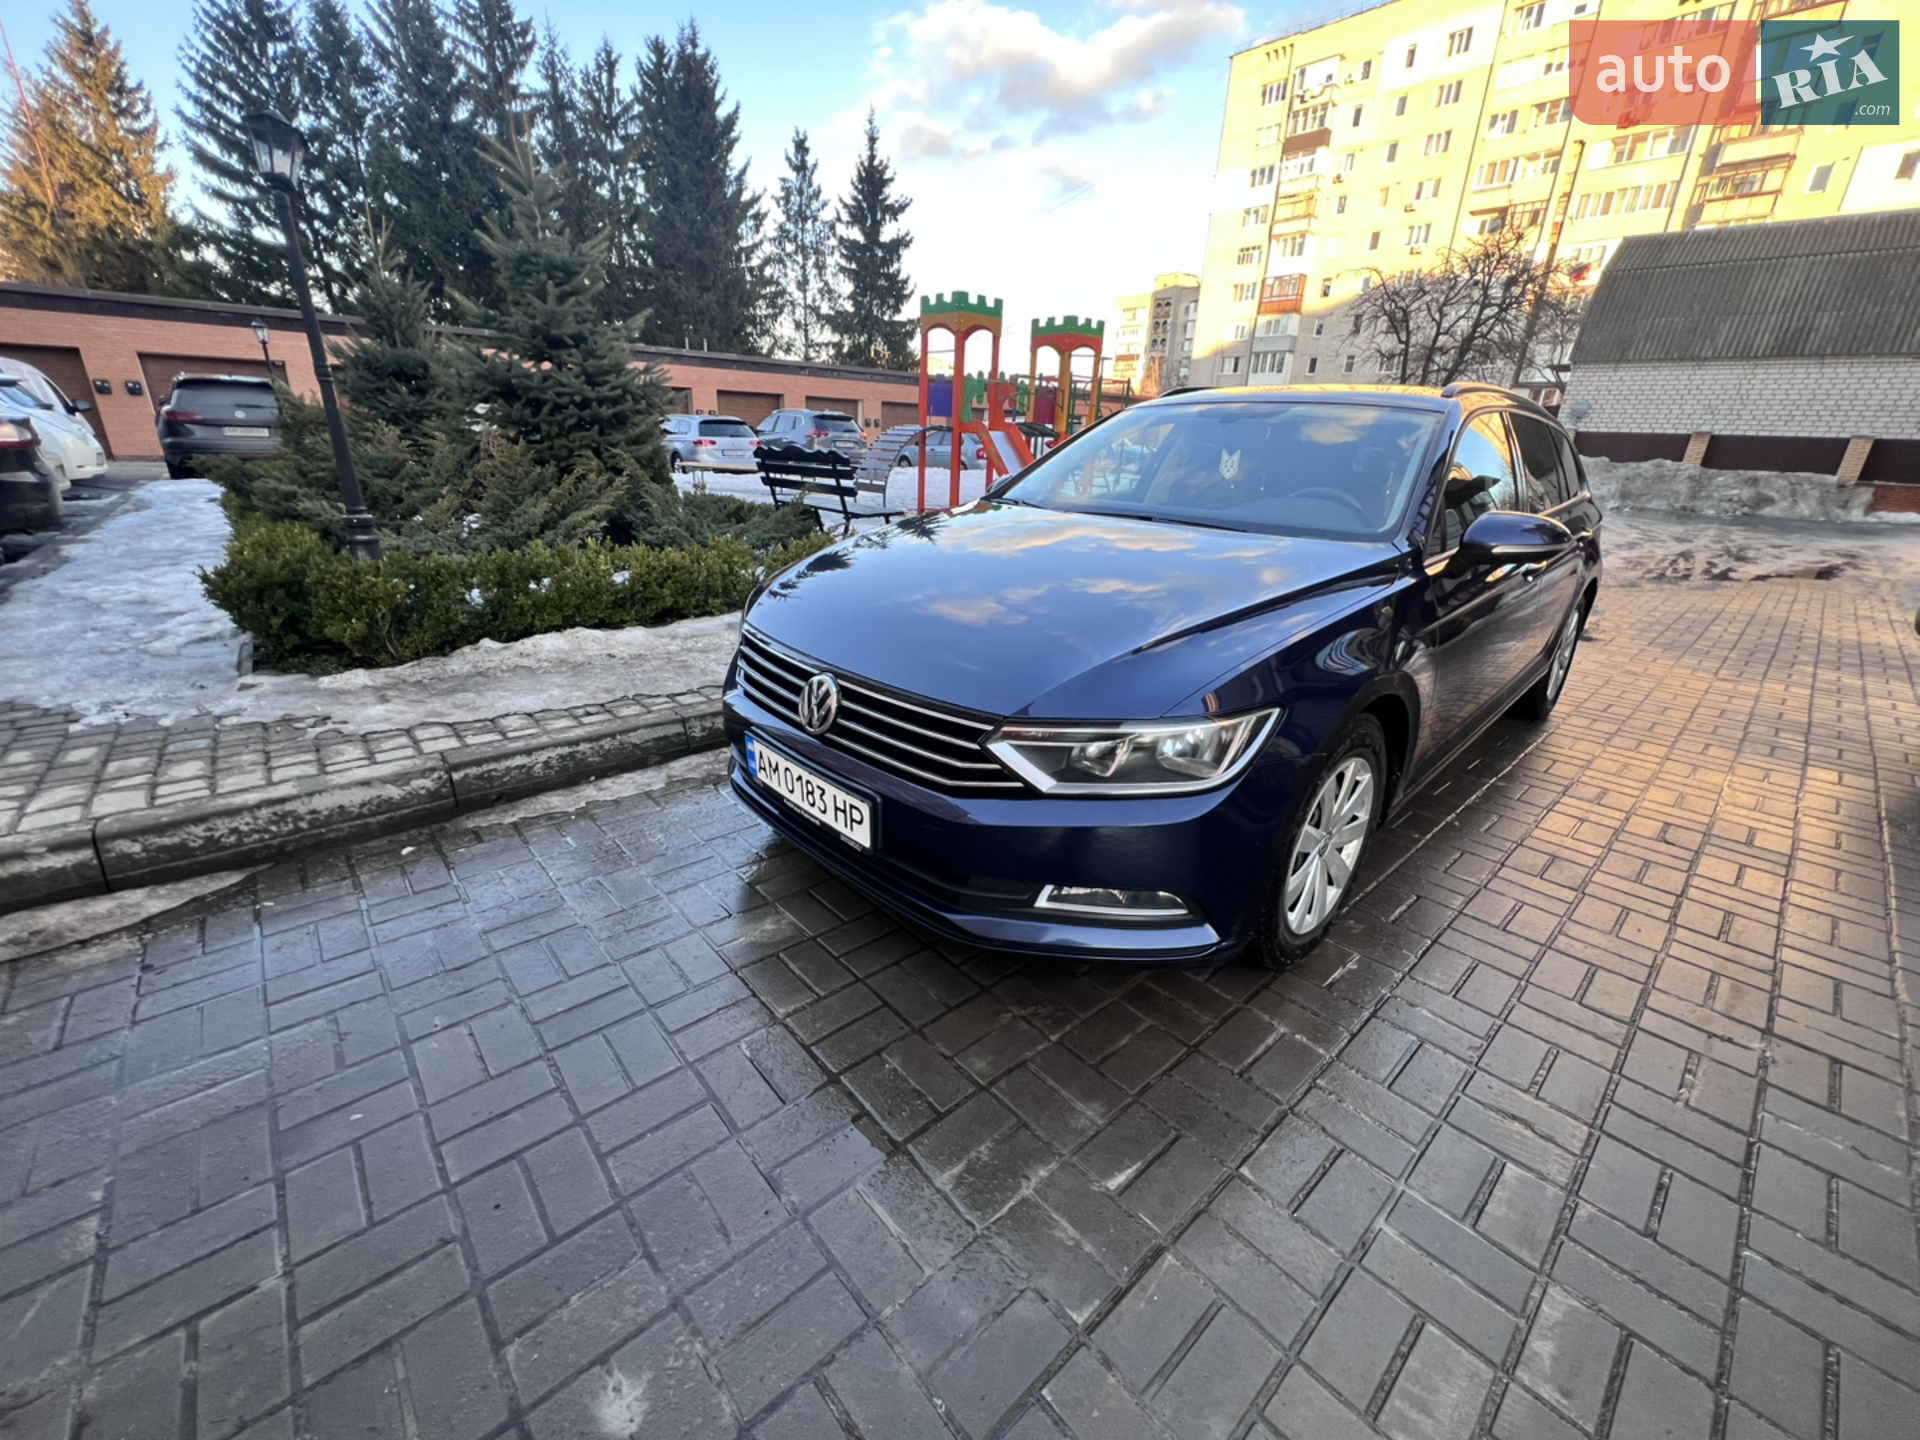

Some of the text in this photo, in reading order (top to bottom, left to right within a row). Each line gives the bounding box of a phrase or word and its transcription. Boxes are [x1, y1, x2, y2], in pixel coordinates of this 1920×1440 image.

[758, 750, 782, 787] AM
[784, 767, 828, 815] 0183
[832, 794, 865, 832] HP
